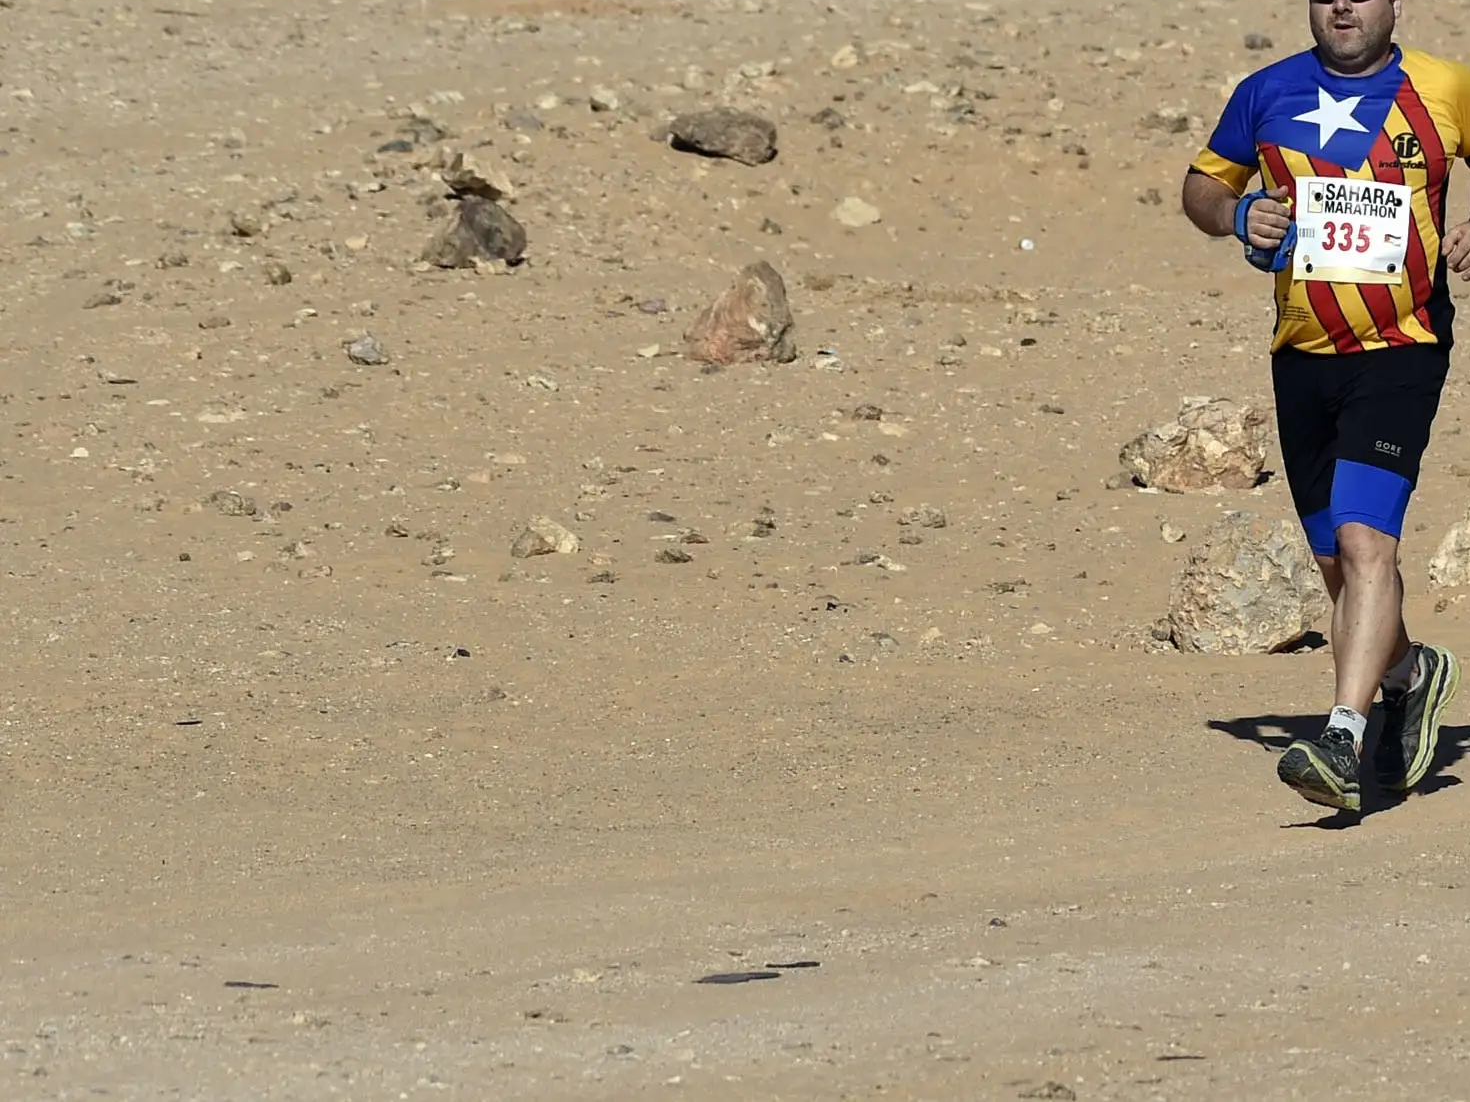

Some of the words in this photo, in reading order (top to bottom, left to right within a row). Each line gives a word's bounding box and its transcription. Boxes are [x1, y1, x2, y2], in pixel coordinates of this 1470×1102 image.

[1325, 183, 1397, 206] SAHARA
[1324, 201, 1397, 219] MARATHON
[1321, 221, 1372, 253] 335
[1375, 440, 1403, 454] GORE
